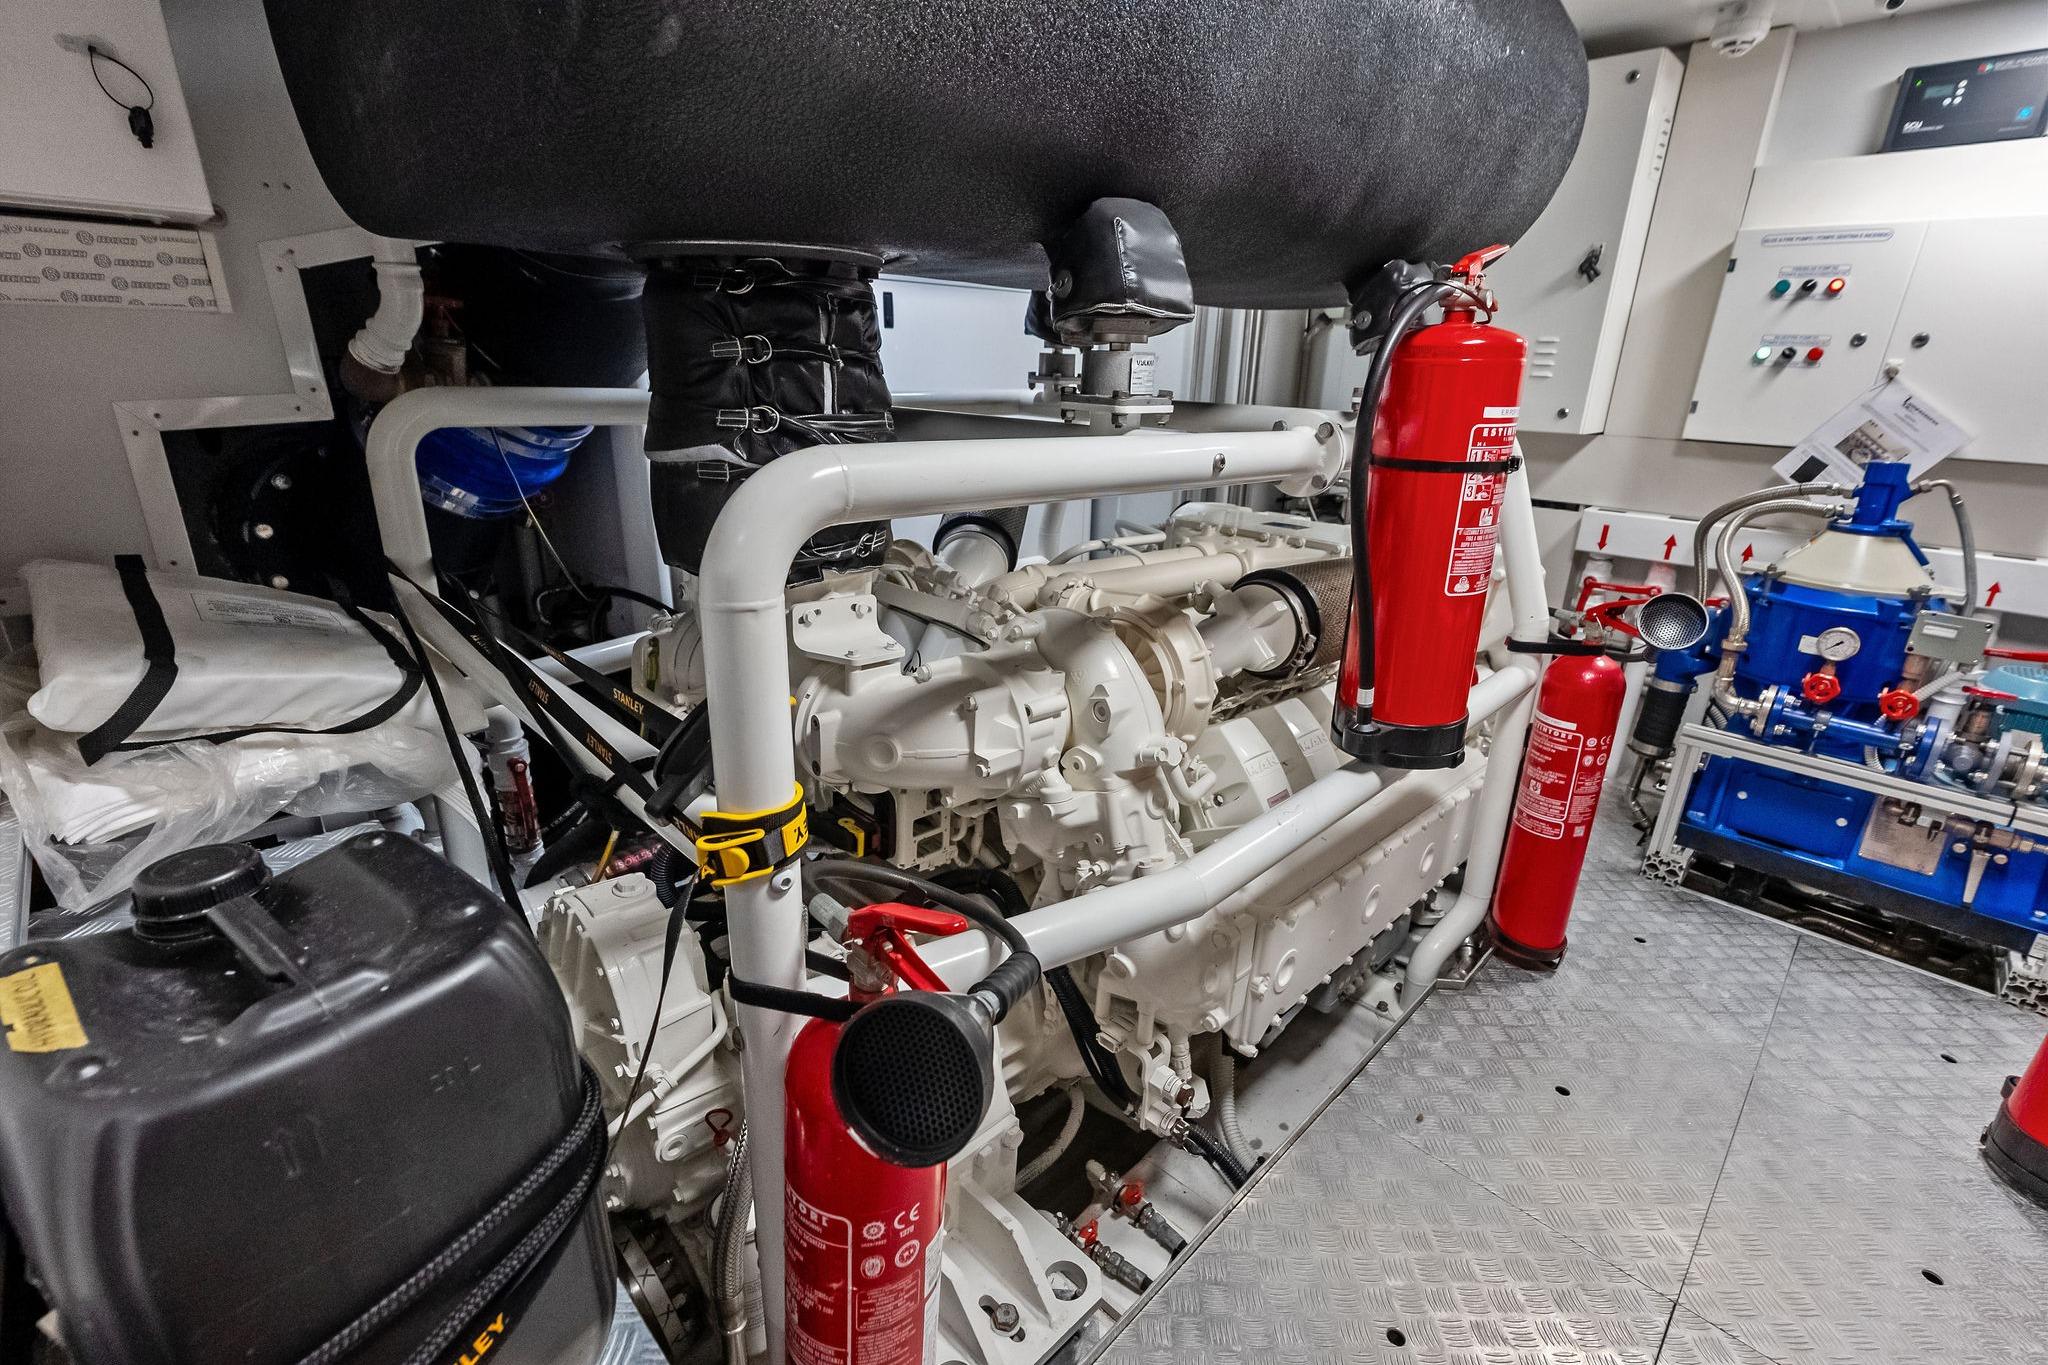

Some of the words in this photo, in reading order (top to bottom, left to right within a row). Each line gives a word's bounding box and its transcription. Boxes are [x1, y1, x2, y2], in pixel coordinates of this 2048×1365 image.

[1467, 486, 1473, 498] 3
[613, 687, 645, 715] STANLEY
[586, 732, 614, 765] STANLEY
[893, 1201, 921, 1230] CE
[455, 1311, 505, 1365] LEY
